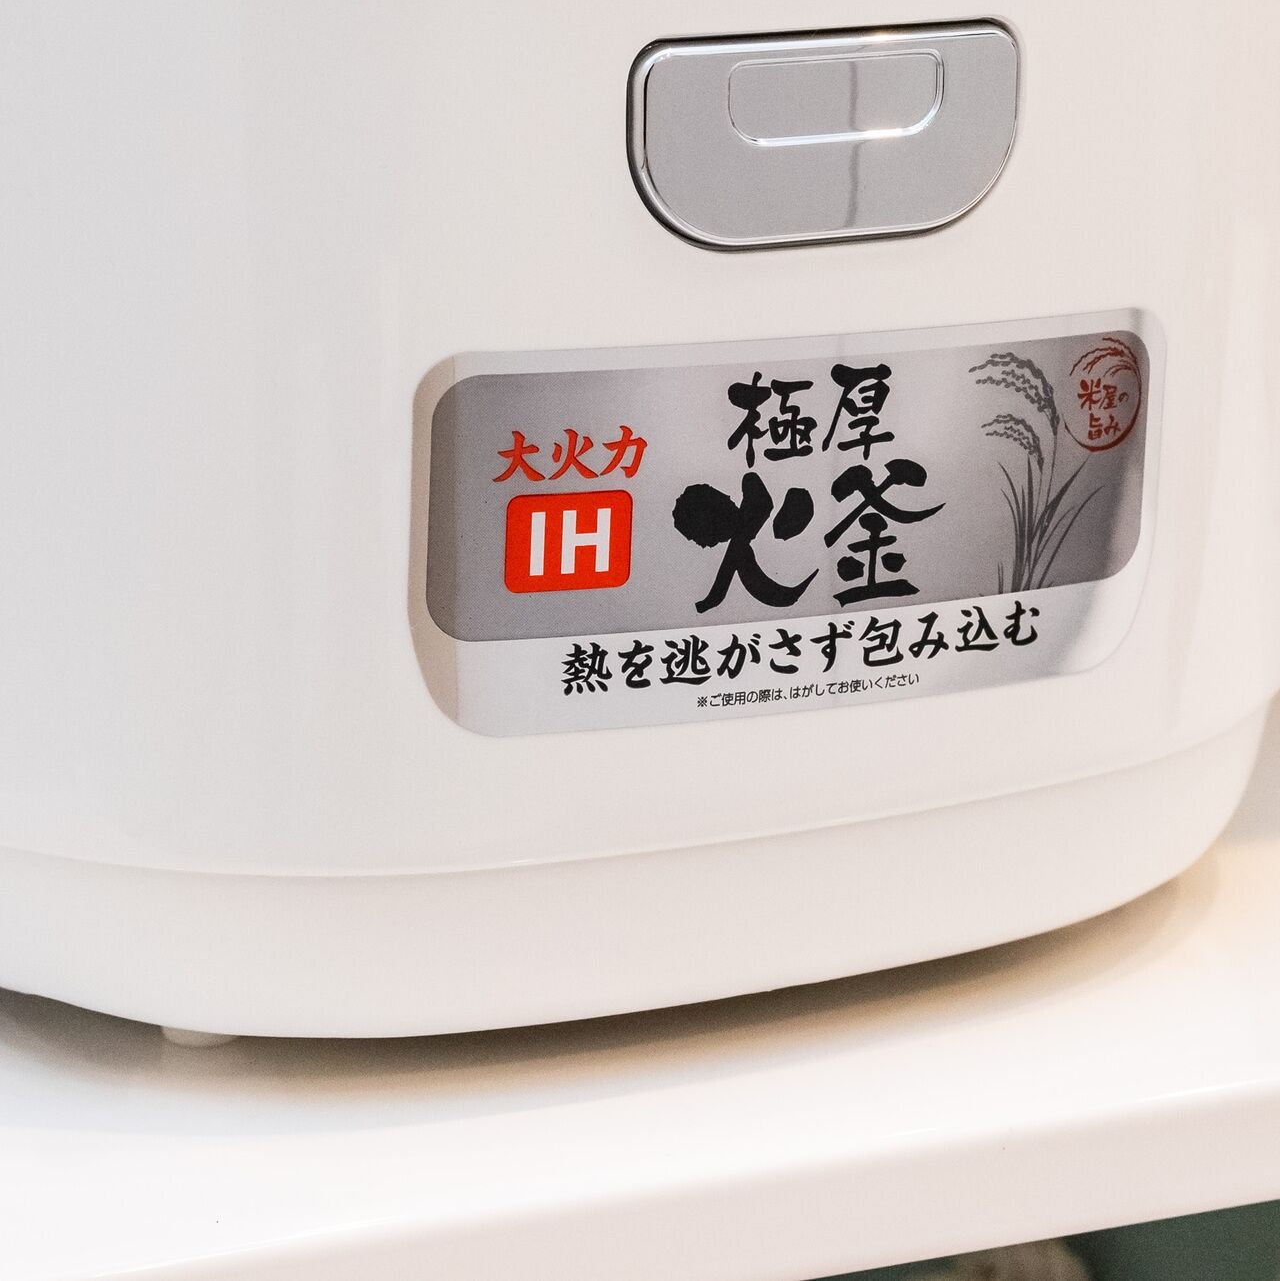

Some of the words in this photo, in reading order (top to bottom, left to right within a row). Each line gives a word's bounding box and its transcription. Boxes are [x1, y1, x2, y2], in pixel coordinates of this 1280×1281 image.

[726, 363, 896, 468] 極厚
[1087, 413, 1121, 440] 旨み
[492, 425, 648, 483] 大火力
[528, 508, 610, 577] IH
[560, 600, 1040, 697] 熱を逃がさず包み込む
